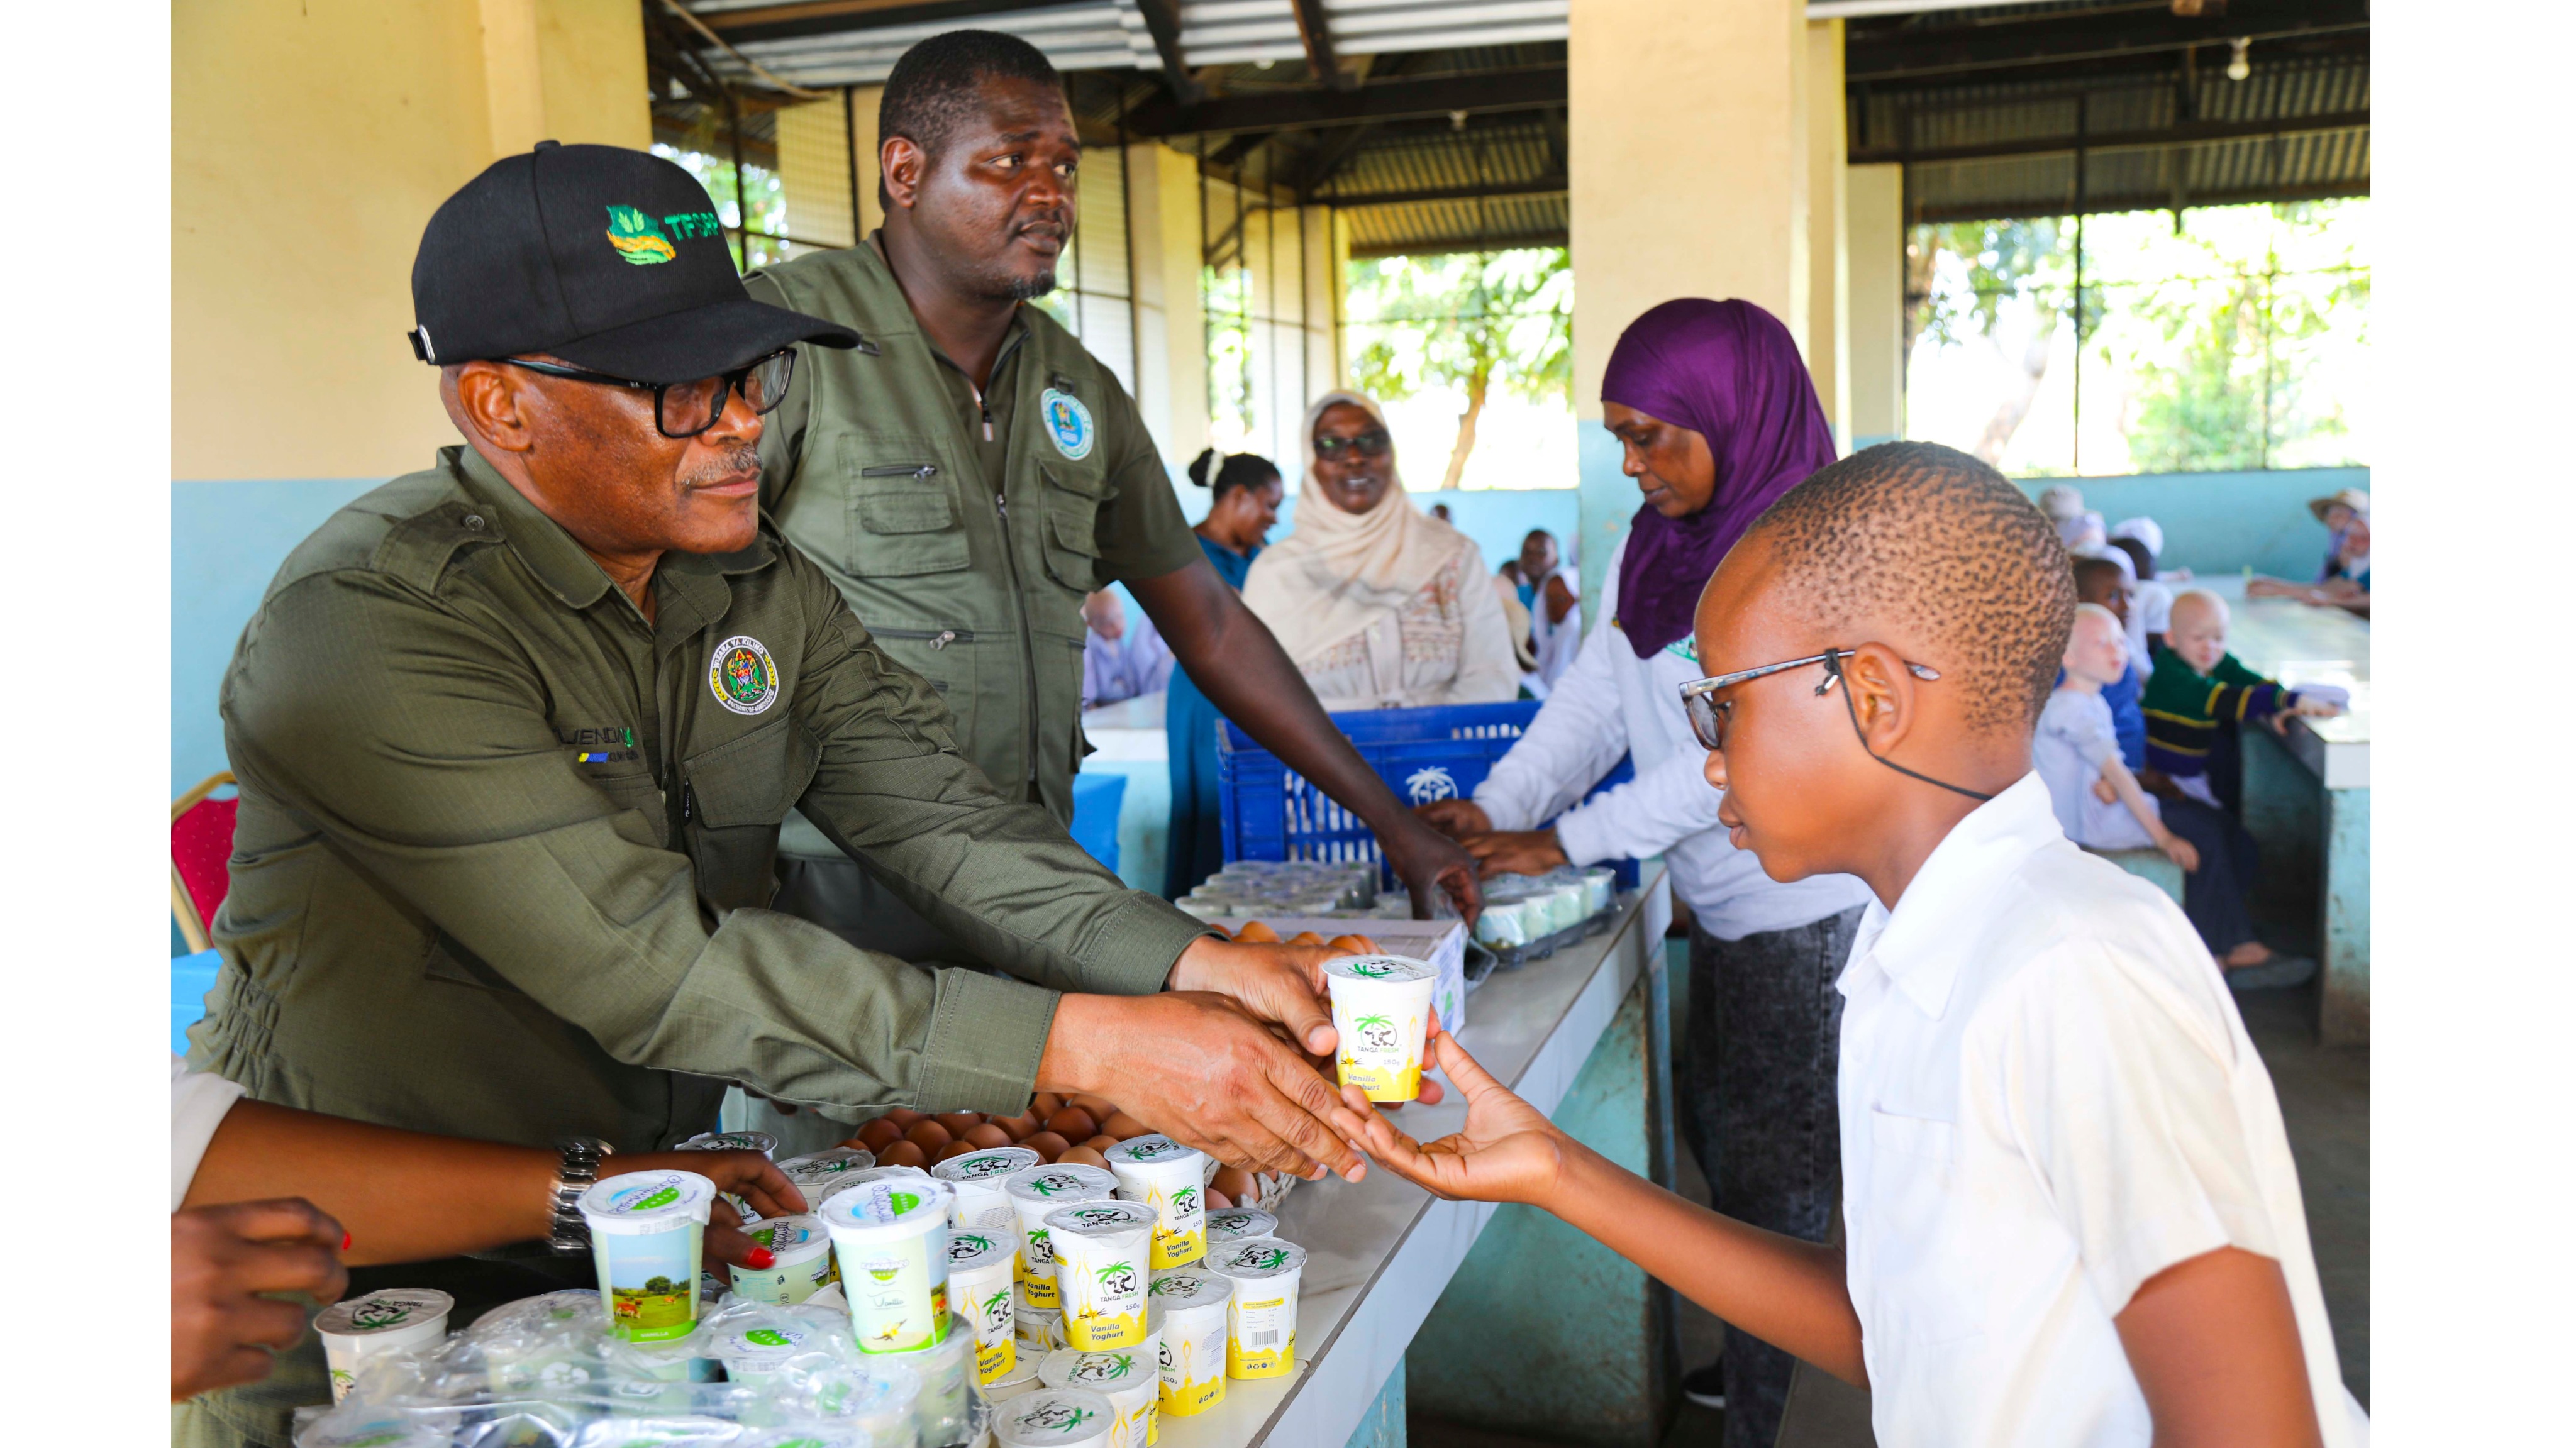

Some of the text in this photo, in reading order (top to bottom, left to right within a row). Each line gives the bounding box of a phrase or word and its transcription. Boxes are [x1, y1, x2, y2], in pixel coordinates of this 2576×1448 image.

[713, 643, 731, 668] WIZARA
[742, 638, 763, 654] KILIMO
[1348, 1073, 1375, 1082] Vanilla
[961, 1171, 989, 1180] TANGA
[990, 1167, 1014, 1176] FRESH
[1167, 1240, 1189, 1251] Vanilla
[1167, 1246, 1192, 1257] Yoghurt
[1027, 1281, 1050, 1290] Vanilla
[1028, 1288, 1055, 1298] Yoghurt
[1122, 1291, 1138, 1299] FRESH
[874, 1297, 904, 1307] Vanilla
[987, 1323, 1003, 1334] TANGA
[1091, 1323, 1120, 1332] Vanilla
[1092, 1330, 1124, 1340] Yoghurt
[979, 1351, 1002, 1366] Vanilla
[980, 1357, 1005, 1374] Yoghurt
[1068, 1365, 1080, 1381] FRESH
